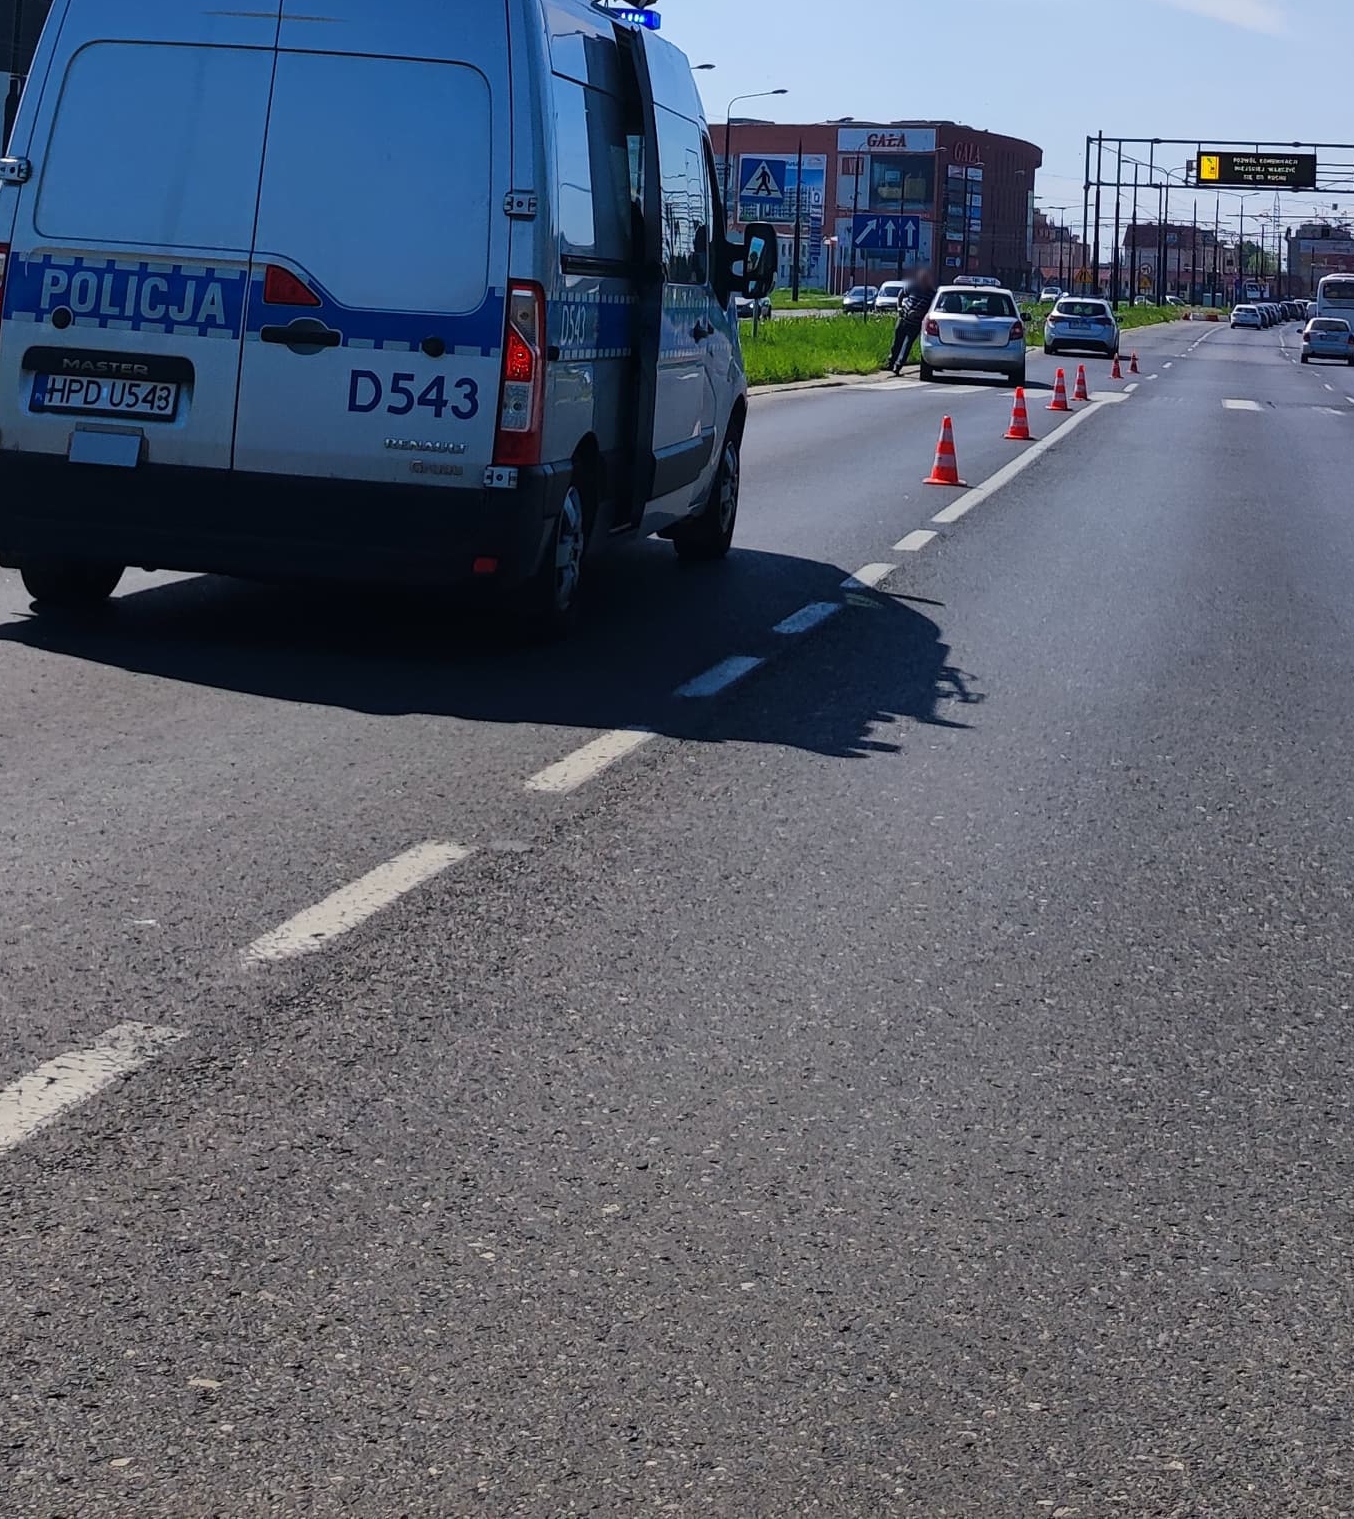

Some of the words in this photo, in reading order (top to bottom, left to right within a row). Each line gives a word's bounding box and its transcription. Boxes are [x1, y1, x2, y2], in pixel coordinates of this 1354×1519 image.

[40, 268, 225, 325] POLICJA
[561, 305, 586, 346] D543
[62, 358, 147, 375] MASTER
[48, 376, 102, 406] HPD
[109, 381, 172, 411] U543
[348, 369, 479, 419] D543
[385, 438, 467, 454] RENAULT
